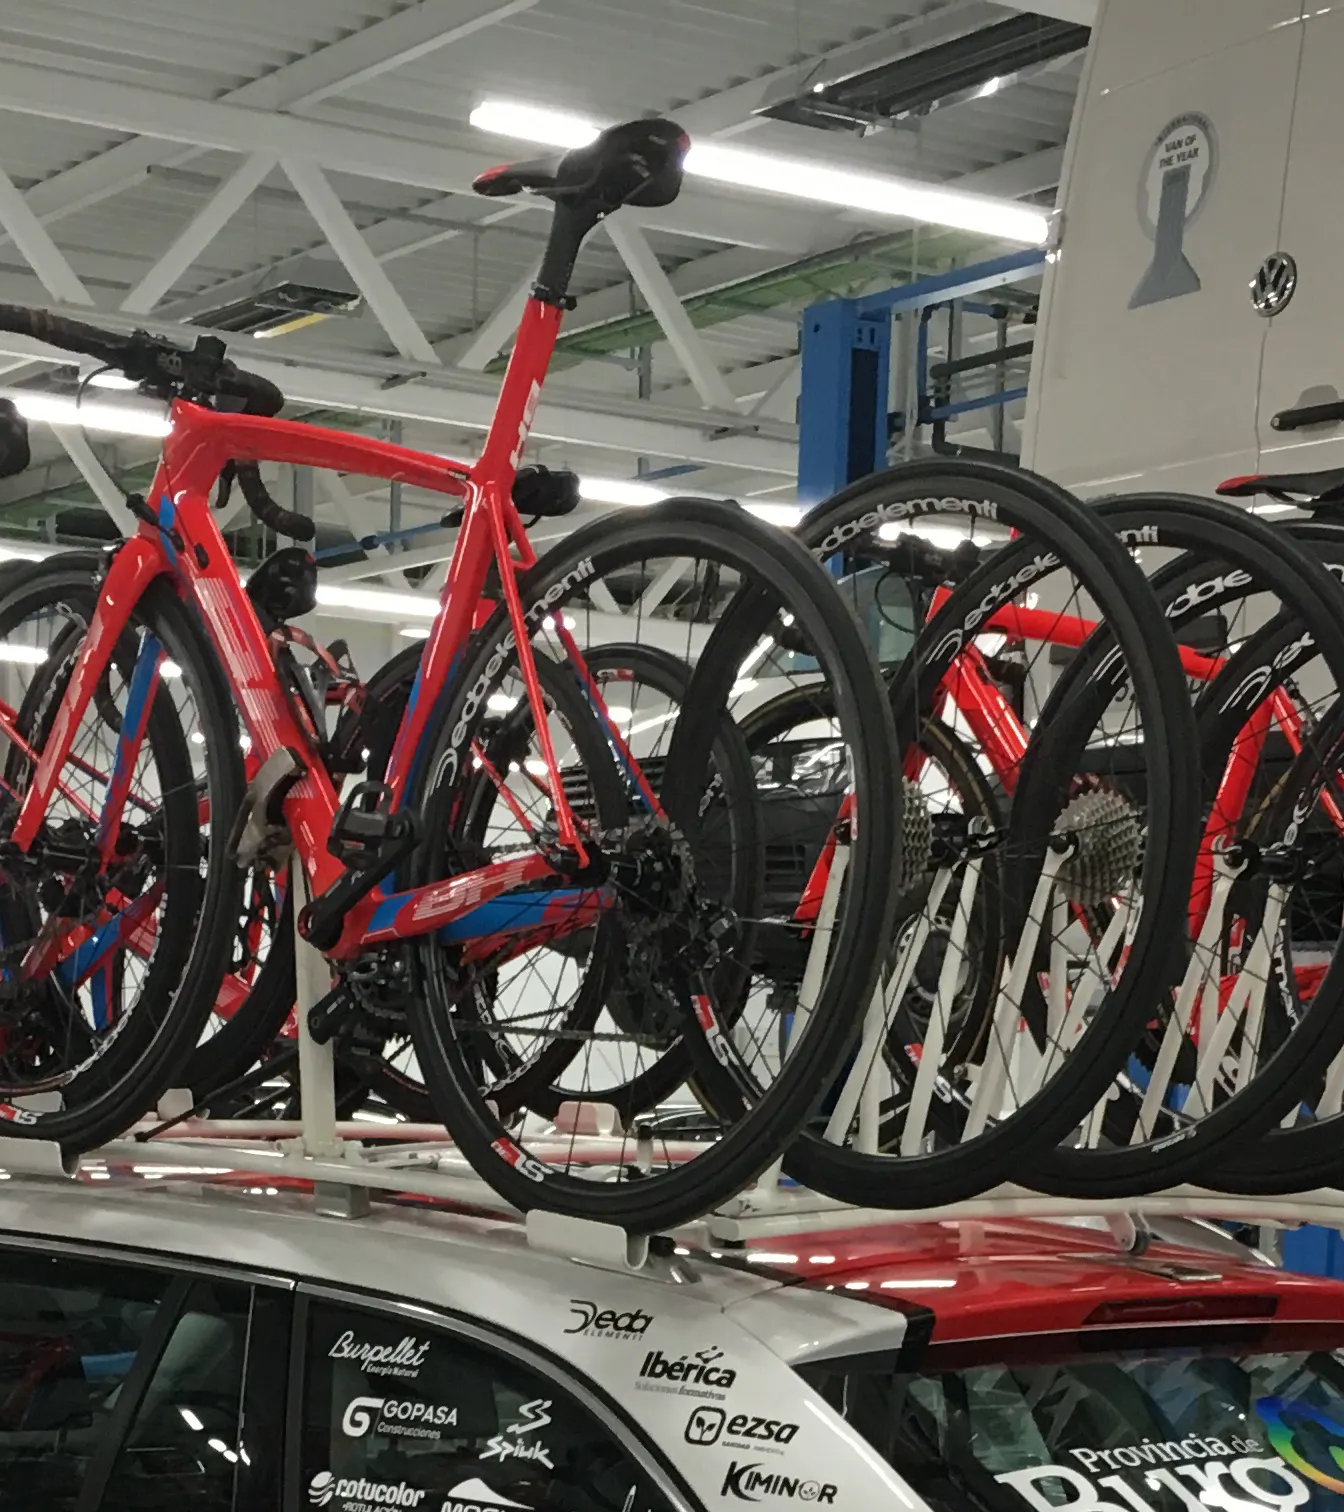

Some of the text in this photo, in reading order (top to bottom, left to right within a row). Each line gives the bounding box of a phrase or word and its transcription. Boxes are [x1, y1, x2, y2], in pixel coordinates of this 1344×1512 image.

[563, 1299, 654, 1335] Deda
[328, 1330, 431, 1371] Burpellet
[583, 1329, 643, 1342] ELEMENTI
[638, 1351, 738, 1389] Ibérica
[383, 1400, 458, 1426] GOPASA
[726, 1413, 801, 1445] ezsa
[1069, 1432, 1265, 1474] Provincia de
[335, 1477, 426, 1508] rotucolor
